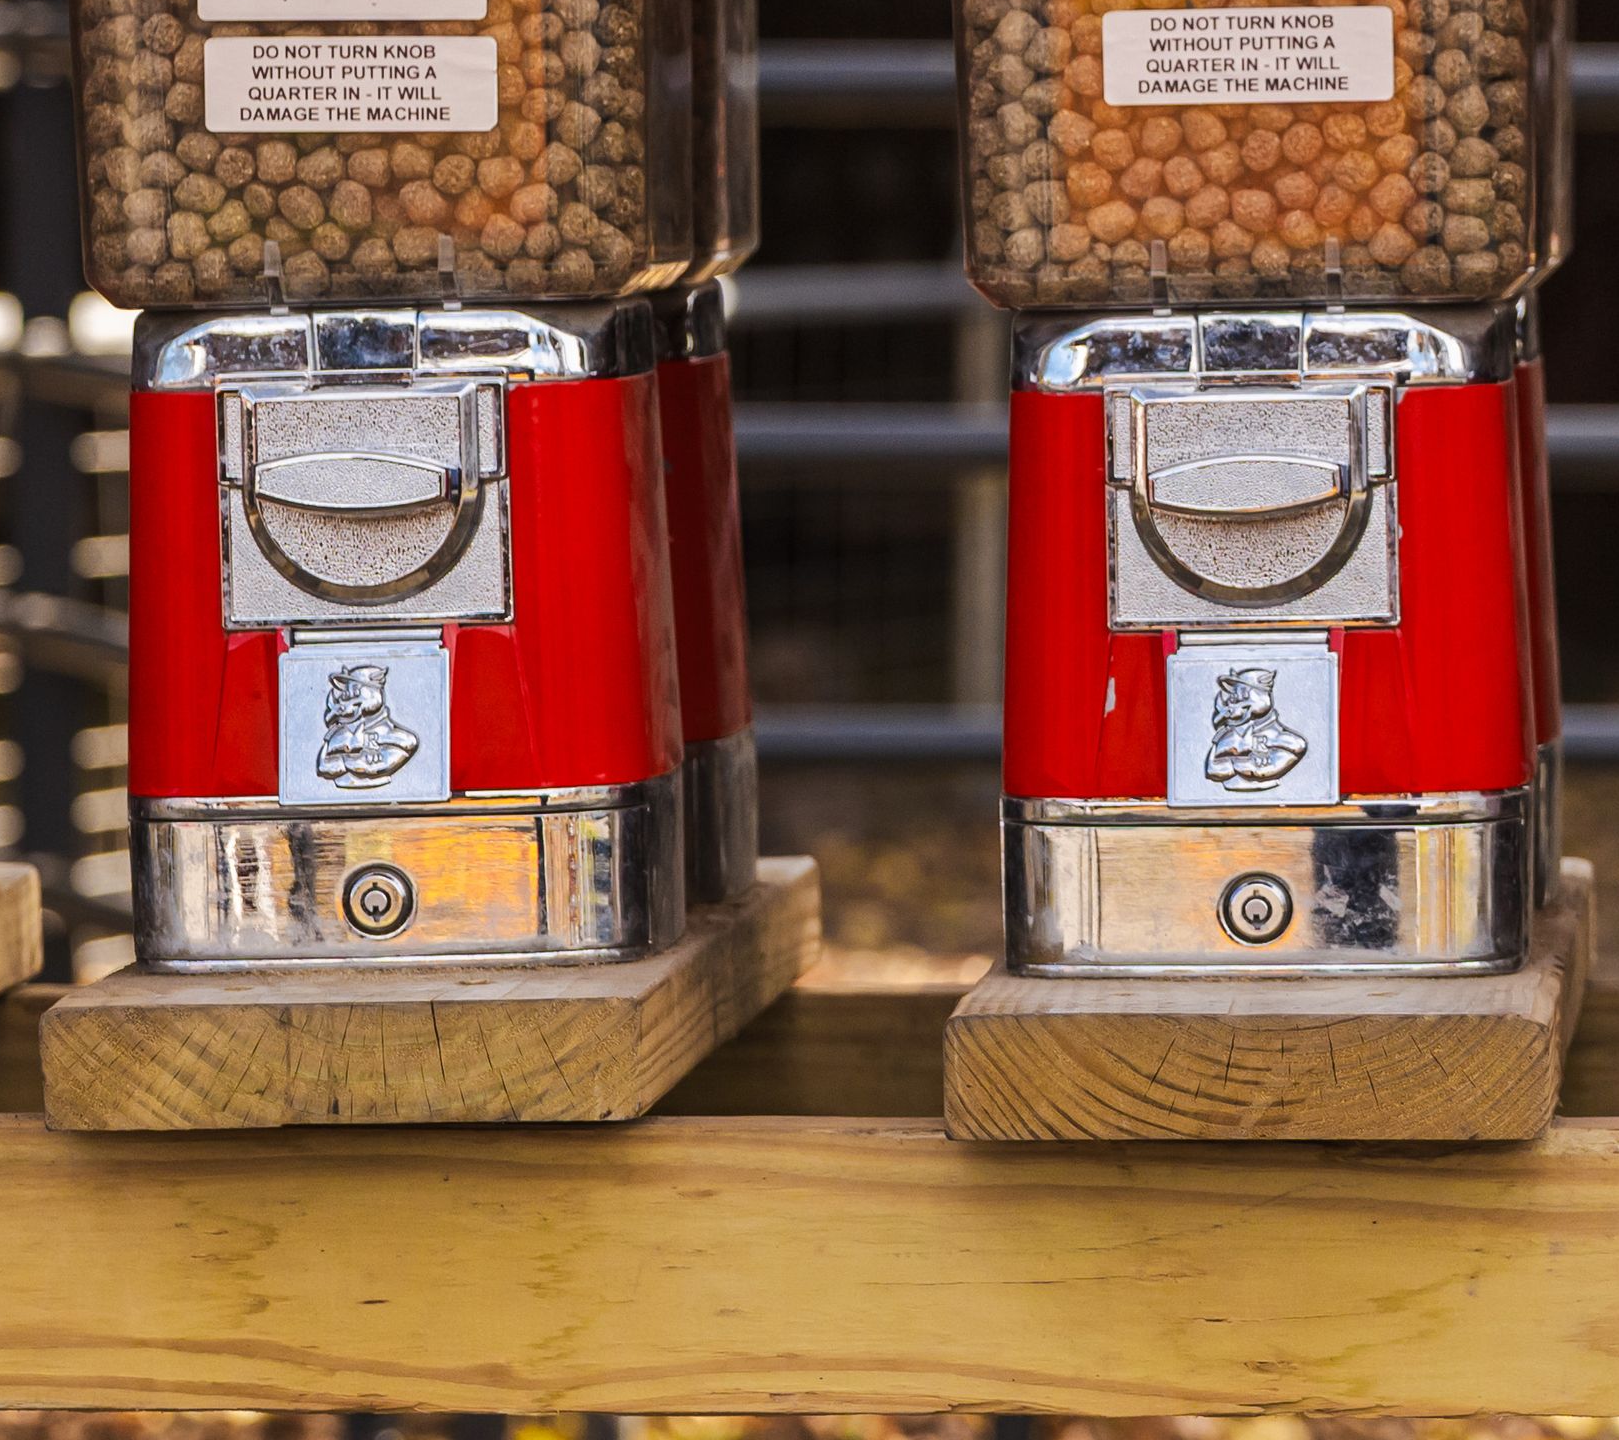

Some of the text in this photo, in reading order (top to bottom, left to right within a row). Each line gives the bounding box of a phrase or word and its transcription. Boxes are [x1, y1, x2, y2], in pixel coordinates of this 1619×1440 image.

[1150, 14, 1334, 32] DO NOT TURN KNOB
[252, 44, 436, 60] DO NOT TURN KNOB
[1149, 34, 1336, 53] WITHOUT PUTTING A
[251, 64, 437, 80] WITHOUT PUTTING A
[1145, 57, 1236, 74] QUARTER
[1241, 57, 1259, 72] IN
[1275, 56, 1291, 71] IT
[1295, 55, 1340, 71] WILL
[247, 85, 338, 102] QUARTER
[343, 86, 361, 101] IN
[377, 85, 393, 101] IT
[397, 85, 442, 101] WILL
[1138, 75, 1349, 95] DAMAGE THE MACHINE
[239, 106, 451, 122] DAMAGE THE MACHINE
